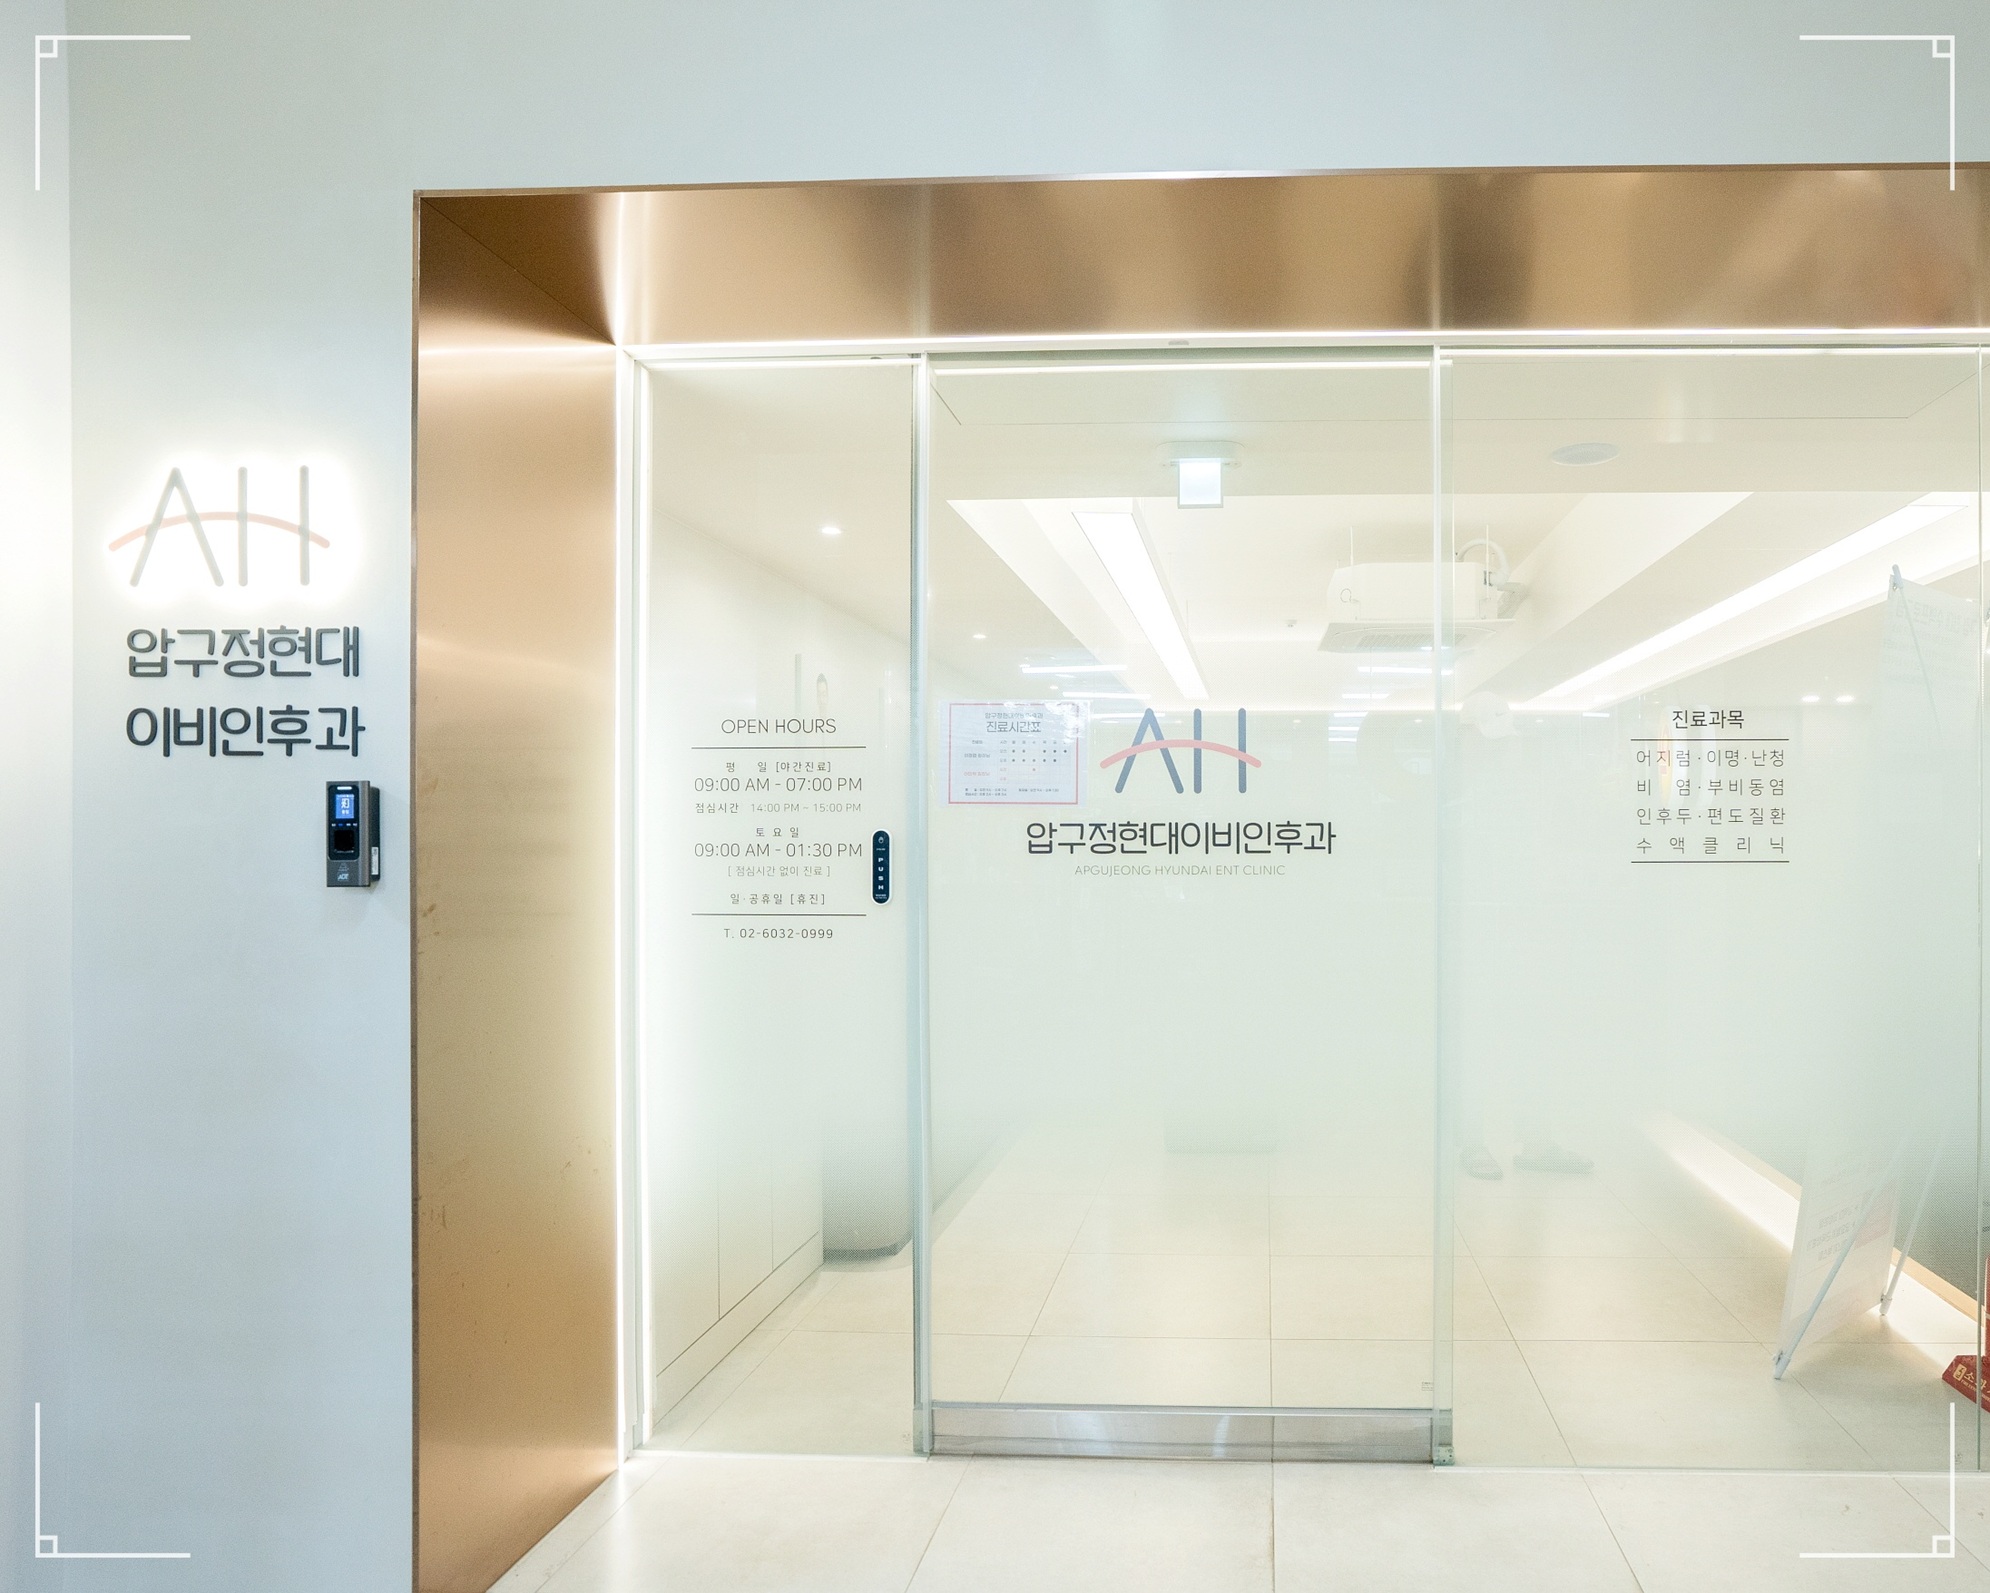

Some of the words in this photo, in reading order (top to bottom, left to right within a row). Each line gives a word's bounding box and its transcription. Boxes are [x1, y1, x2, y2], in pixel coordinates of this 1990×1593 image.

[108, 466, 330, 587] AH
[126, 625, 360, 678] 압구정현대
[984, 712, 1043, 720] 압구정현대이비과
[1673, 710, 1744, 729] 진료과목
[126, 705, 366, 757] 이비인후과
[721, 719, 768, 733] OPEN
[776, 718, 836, 733] HOURS
[986, 721, 1042, 733] 진료시간표
[1099, 708, 1262, 794] AH
[776, 762, 831, 773] [야간진료]
[695, 778, 740, 791] 09:00
[745, 778, 769, 791] AM
[786, 778, 832, 791] 07:00
[838, 778, 861, 791] PM
[696, 803, 738, 813] 점심시간
[751, 803, 780, 812] 14:00
[784, 803, 799, 812] PM
[813, 803, 843, 812] 15:00
[846, 801, 861, 811] PM
[1027, 821, 1336, 854] 압구정현대이비인후과
[695, 843, 740, 857] 09:00
[745, 843, 769, 856] AM
[786, 843, 832, 857] 01:30
[838, 843, 862, 856] PM
[736, 865, 776, 877] 점심시간
[779, 864, 798, 877] 없이
[803, 866, 822, 877] 진료
[1075, 865, 1151, 877] APGUJEONG
[1155, 865, 1211, 875] HYUNDAI
[1216, 865, 1239, 875] ENT
[1242, 864, 1285, 875] CLINIC
[791, 894, 824, 905] [휴진]
[724, 929, 734, 938] T.
[740, 929, 832, 938] 02-6032-0999
